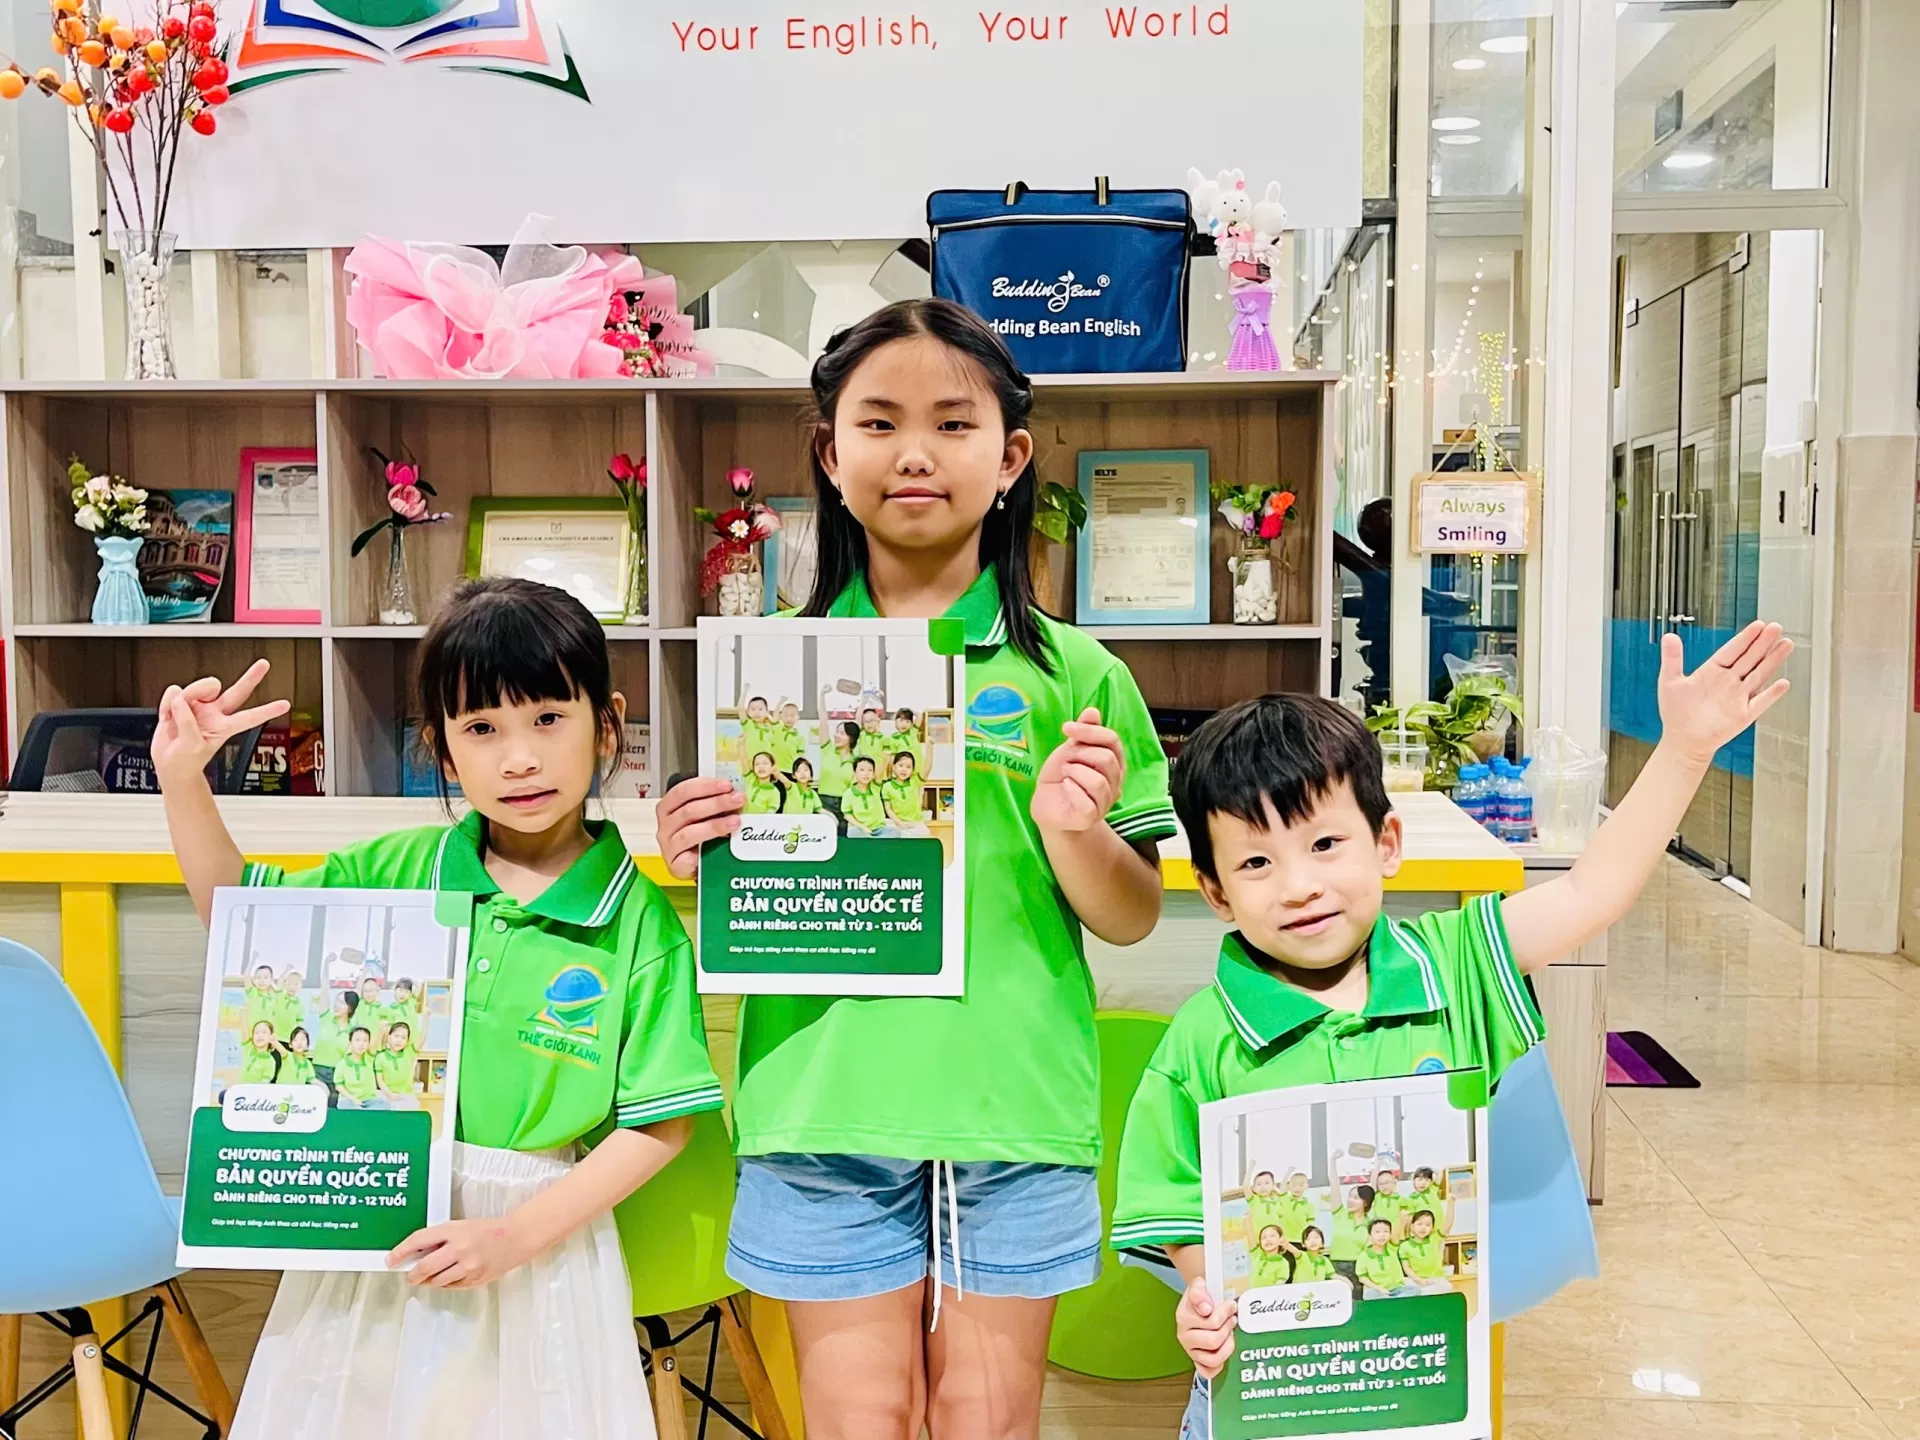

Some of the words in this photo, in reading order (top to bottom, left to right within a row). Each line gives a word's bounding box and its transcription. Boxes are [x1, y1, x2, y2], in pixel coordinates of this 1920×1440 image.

[671, 20, 758, 52] Your
[787, 14, 938, 55] English,
[979, 11, 1068, 43] Your
[1105, 3, 1228, 39] World
[989, 319, 1035, 338] dding
[1038, 320, 1080, 335] Bean
[1084, 318, 1141, 337] English
[1440, 498, 1505, 517] Always
[1437, 526, 1507, 545] Smiling
[146, 594, 181, 607] nglish
[248, 746, 287, 773] LTS
[1003, 756, 1034, 776] XANH
[116, 767, 161, 791] IEL
[730, 877, 795, 890] CHƯƠNG
[797, 875, 842, 890] TRÌNH
[845, 873, 889, 890] TIẾNG
[891, 878, 922, 890] ANH
[730, 892, 769, 913] BẢN
[841, 892, 896, 916] QUỐC
[899, 892, 924, 913] TẾ
[799, 921, 821, 931] CHO
[865, 922, 873, 931] 3
[882, 922, 893, 931] 12
[568, 1043, 601, 1065] XANH
[218, 1148, 282, 1162] CHƯƠNG
[284, 1146, 329, 1163] TRÌNH
[331, 1146, 374, 1164] TIẾNG
[376, 1152, 409, 1165] ANH
[216, 1162, 255, 1184] BẢN
[326, 1165, 381, 1189] QUỐC
[384, 1165, 411, 1188] TẾ
[282, 1194, 306, 1204] CHO
[349, 1196, 356, 1205] 3
[364, 1196, 377, 1206] 12
[1239, 1344, 1309, 1362] CHƯƠNG
[1311, 1339, 1360, 1356] TRÌNH
[1362, 1333, 1409, 1351] TIẾNG
[1412, 1333, 1446, 1348] ANH
[1240, 1361, 1282, 1383] BẢN
[1360, 1350, 1419, 1374] QUỐC
[1422, 1345, 1448, 1368] TẾ
[1315, 1383, 1341, 1393] CHO
[1386, 1378, 1394, 1389] 3
[1402, 1377, 1415, 1387] 12
